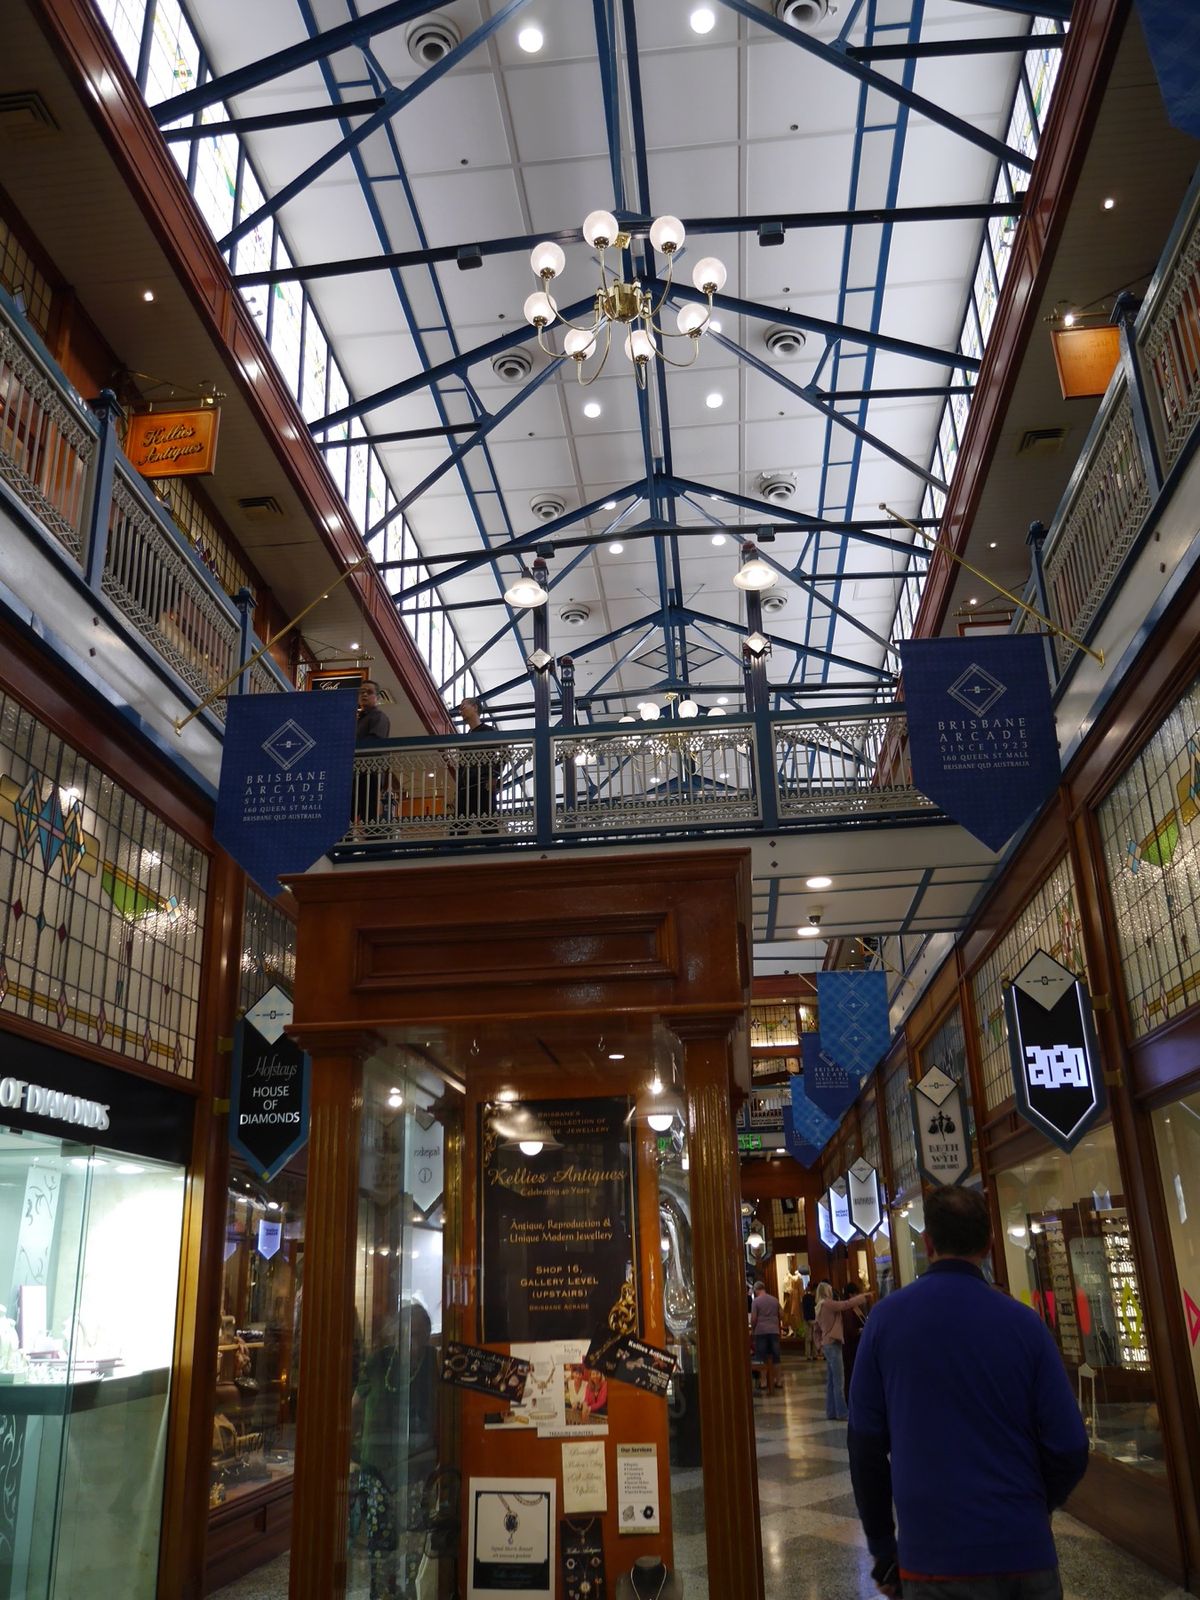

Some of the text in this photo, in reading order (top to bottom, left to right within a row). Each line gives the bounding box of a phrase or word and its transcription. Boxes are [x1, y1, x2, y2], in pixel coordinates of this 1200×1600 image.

[143, 424, 196, 447] Kellies
[138, 443, 204, 466] Antiques
[938, 717, 1026, 731] BRISBANE
[939, 728, 1027, 743] ARCADE
[940, 741, 1028, 753] SINCE 1923
[960, 753, 990, 762] QUEEN
[993, 752, 1003, 760] ST
[1006, 751, 1029, 759] MALL
[943, 760, 1030, 770] BRISBANE QLD AUSTRALIA
[246, 771, 326, 785] BRISBANE
[245, 782, 325, 795] ARCADE
[243, 793, 323, 805] SINCE 1923
[260, 805, 287, 814] QUEEN
[289, 804, 299, 812] ST
[301, 803, 322, 811] MALL
[242, 812, 322, 822] BRISBANE QLD AUSTRALIA
[252, 1086, 290, 1098] HOUSE
[0, 1077, 111, 1130] OF DIAMONDS
[262, 1100, 279, 1111] OF
[240, 1112, 301, 1126] DIAMONDS
[488, 1165, 626, 1187] Kellies Antiques
[510, 1217, 611, 1232] Antique, Reproduction &
[509, 1230, 613, 1243] Unique Modern Jewellery
[536, 1265, 563, 1275] SHOP
[520, 1276, 599, 1288] GALLERY LEVEL
[532, 1289, 588, 1299] (UPSTAIRS)
